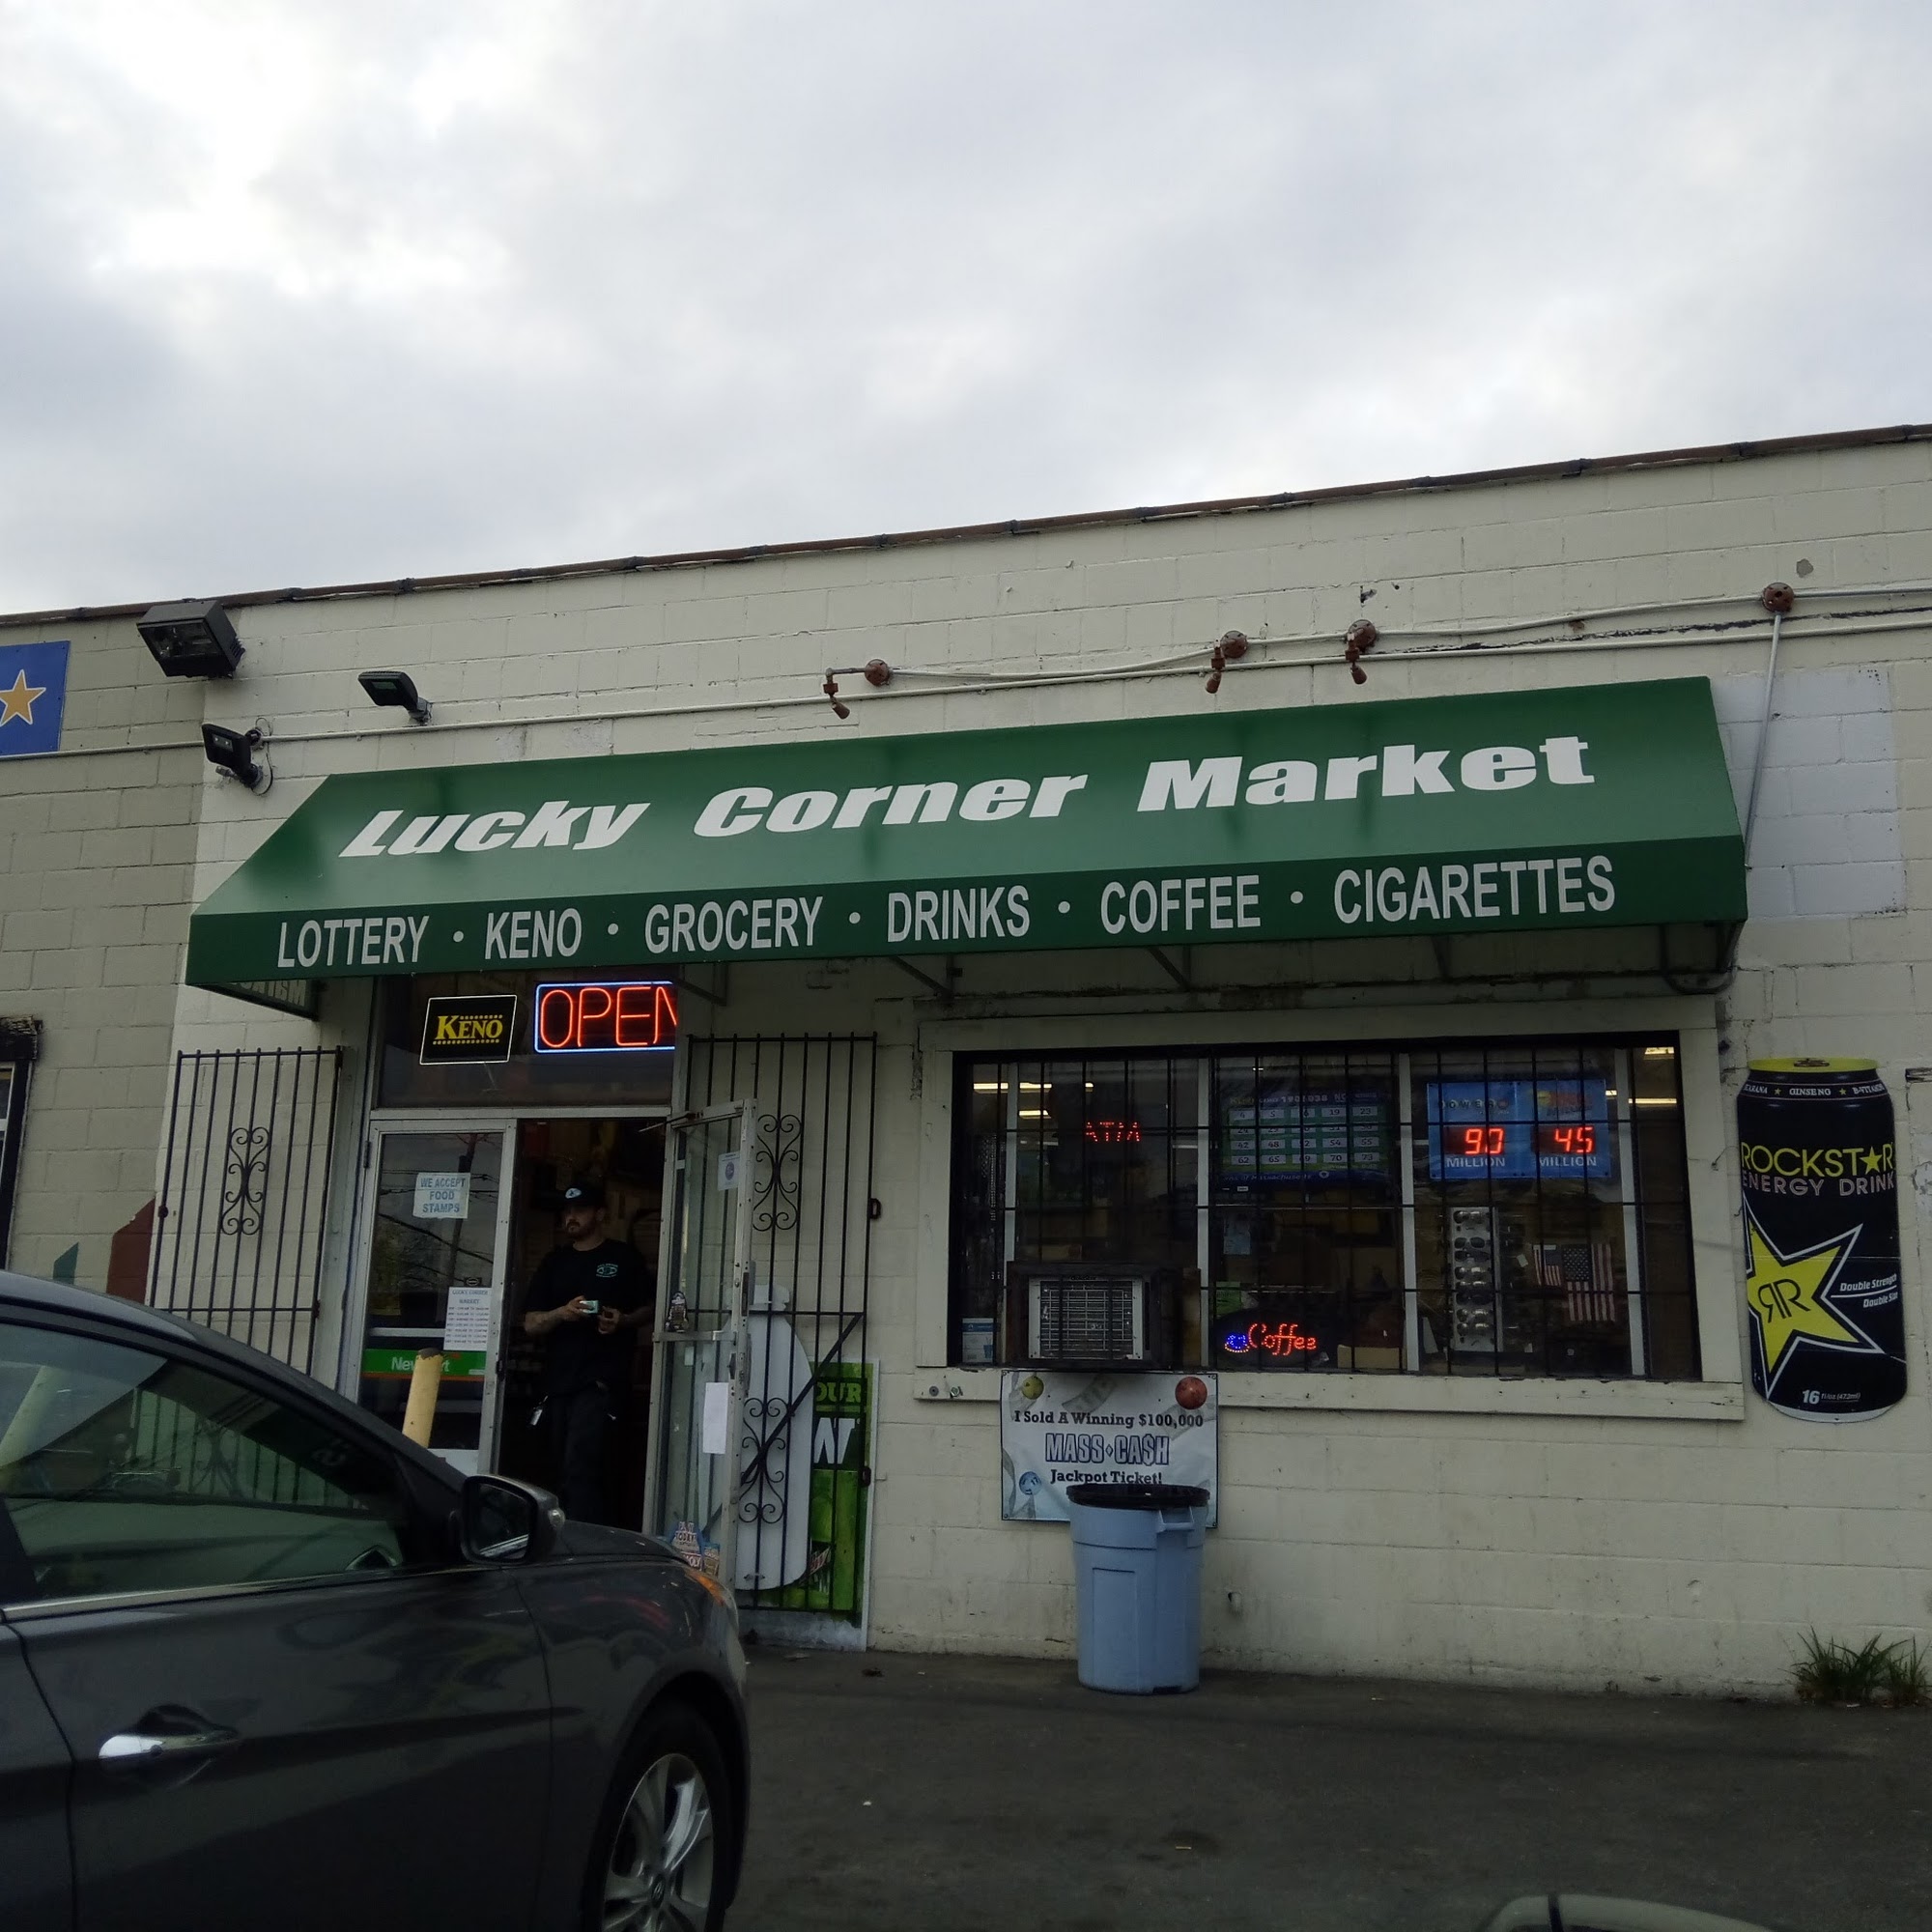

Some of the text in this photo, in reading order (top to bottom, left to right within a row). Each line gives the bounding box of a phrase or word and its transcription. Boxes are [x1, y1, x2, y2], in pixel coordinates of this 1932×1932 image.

[339, 735, 1596, 859] Lucky Corner Market
[277, 855, 1615, 968] LOTTERY KENO GROCERY DRINKS COFFEE CIGARETTES
[435, 1013, 503, 1040] KENO
[1789, 1088, 1832, 1096] GINSENG
[1553, 1126, 1594, 1154] 45
[1445, 1157, 1506, 1168] MILLION
[1539, 1156, 1597, 1166] MILLION
[420, 1178, 467, 1188] WE ACCEPT
[1742, 1169, 1894, 1197] ENERGY DRINK
[429, 1190, 455, 1200] FOOD
[422, 1203, 460, 1213] STAMPS
[1839, 1280, 1871, 1292] Double
[1248, 1322, 1318, 1356] Coffee
[1802, 1389, 1821, 1405] 16
[1014, 1411, 1204, 1429] I Sold A Winning $100,000
[1045, 1433, 1105, 1463] MASS
[1050, 1469, 1162, 1484] Jackpot Ticket!
